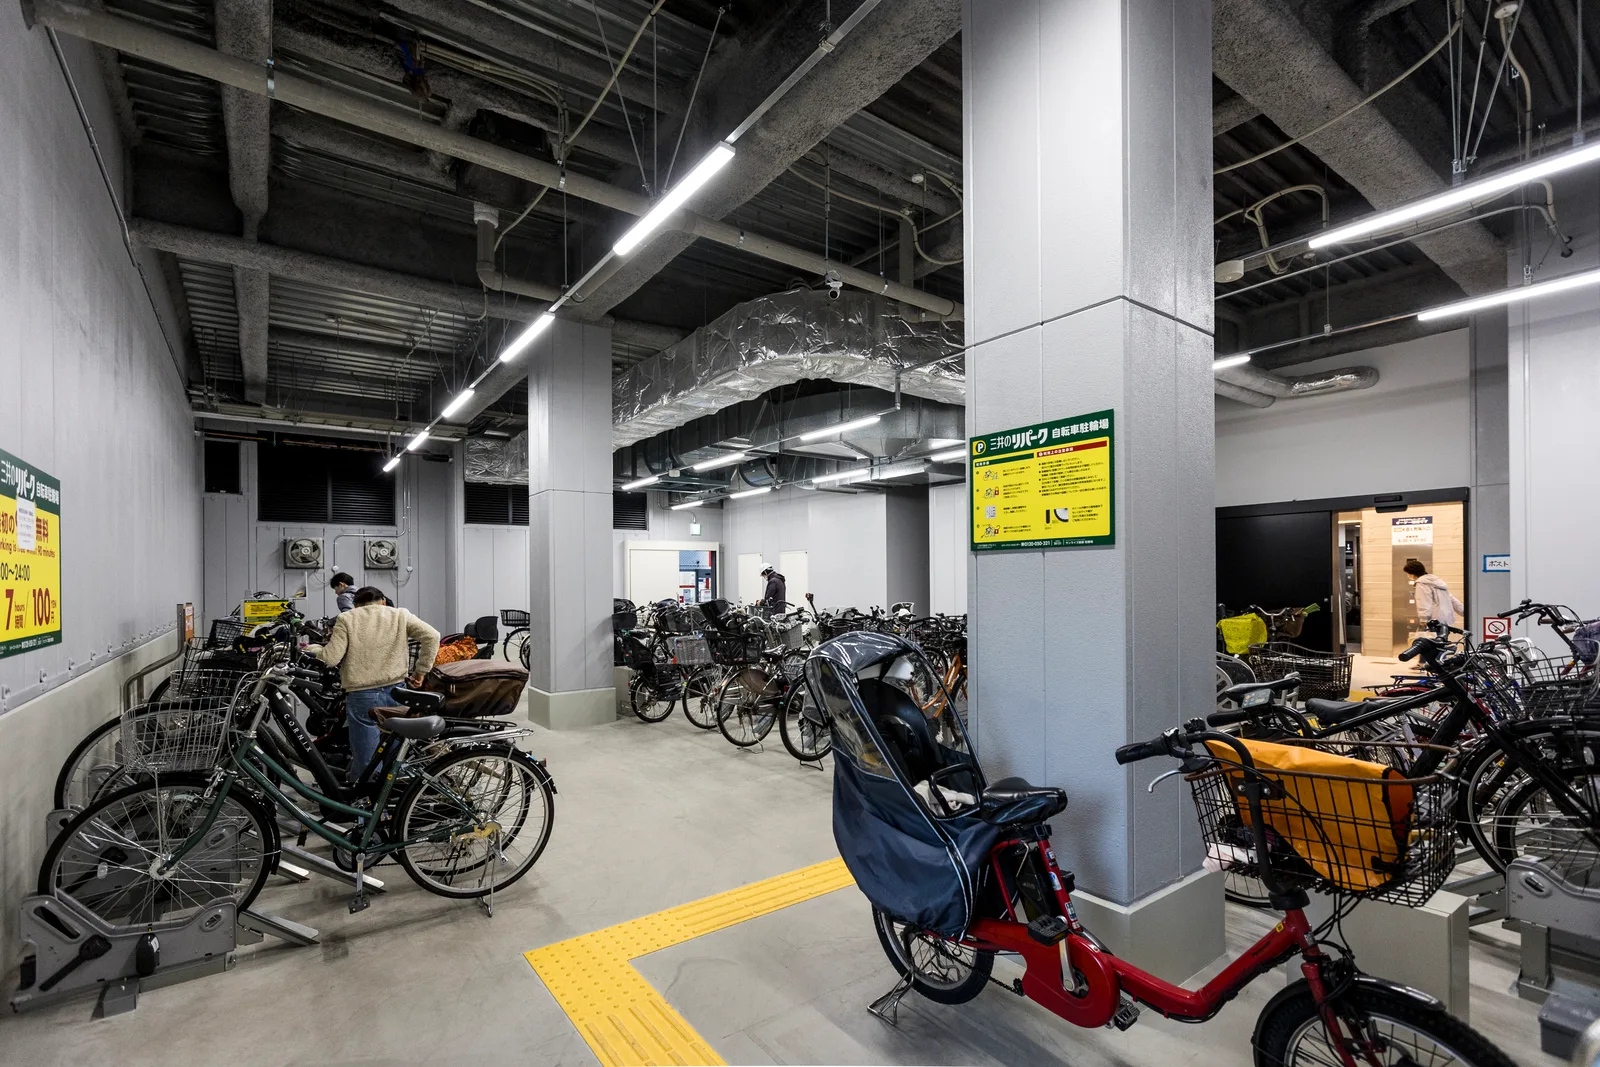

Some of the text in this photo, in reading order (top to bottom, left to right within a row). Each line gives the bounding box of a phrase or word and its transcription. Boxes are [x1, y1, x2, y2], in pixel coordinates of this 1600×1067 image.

[990, 418, 1109, 450] 三井のリパーク 自転車駐輪場
[1, 460, 35, 500] 三井のリパーク
[5, 588, 51, 630] 7 100
[15, 601, 25, 611] hours
[284, 713, 312, 752] CORNIX
